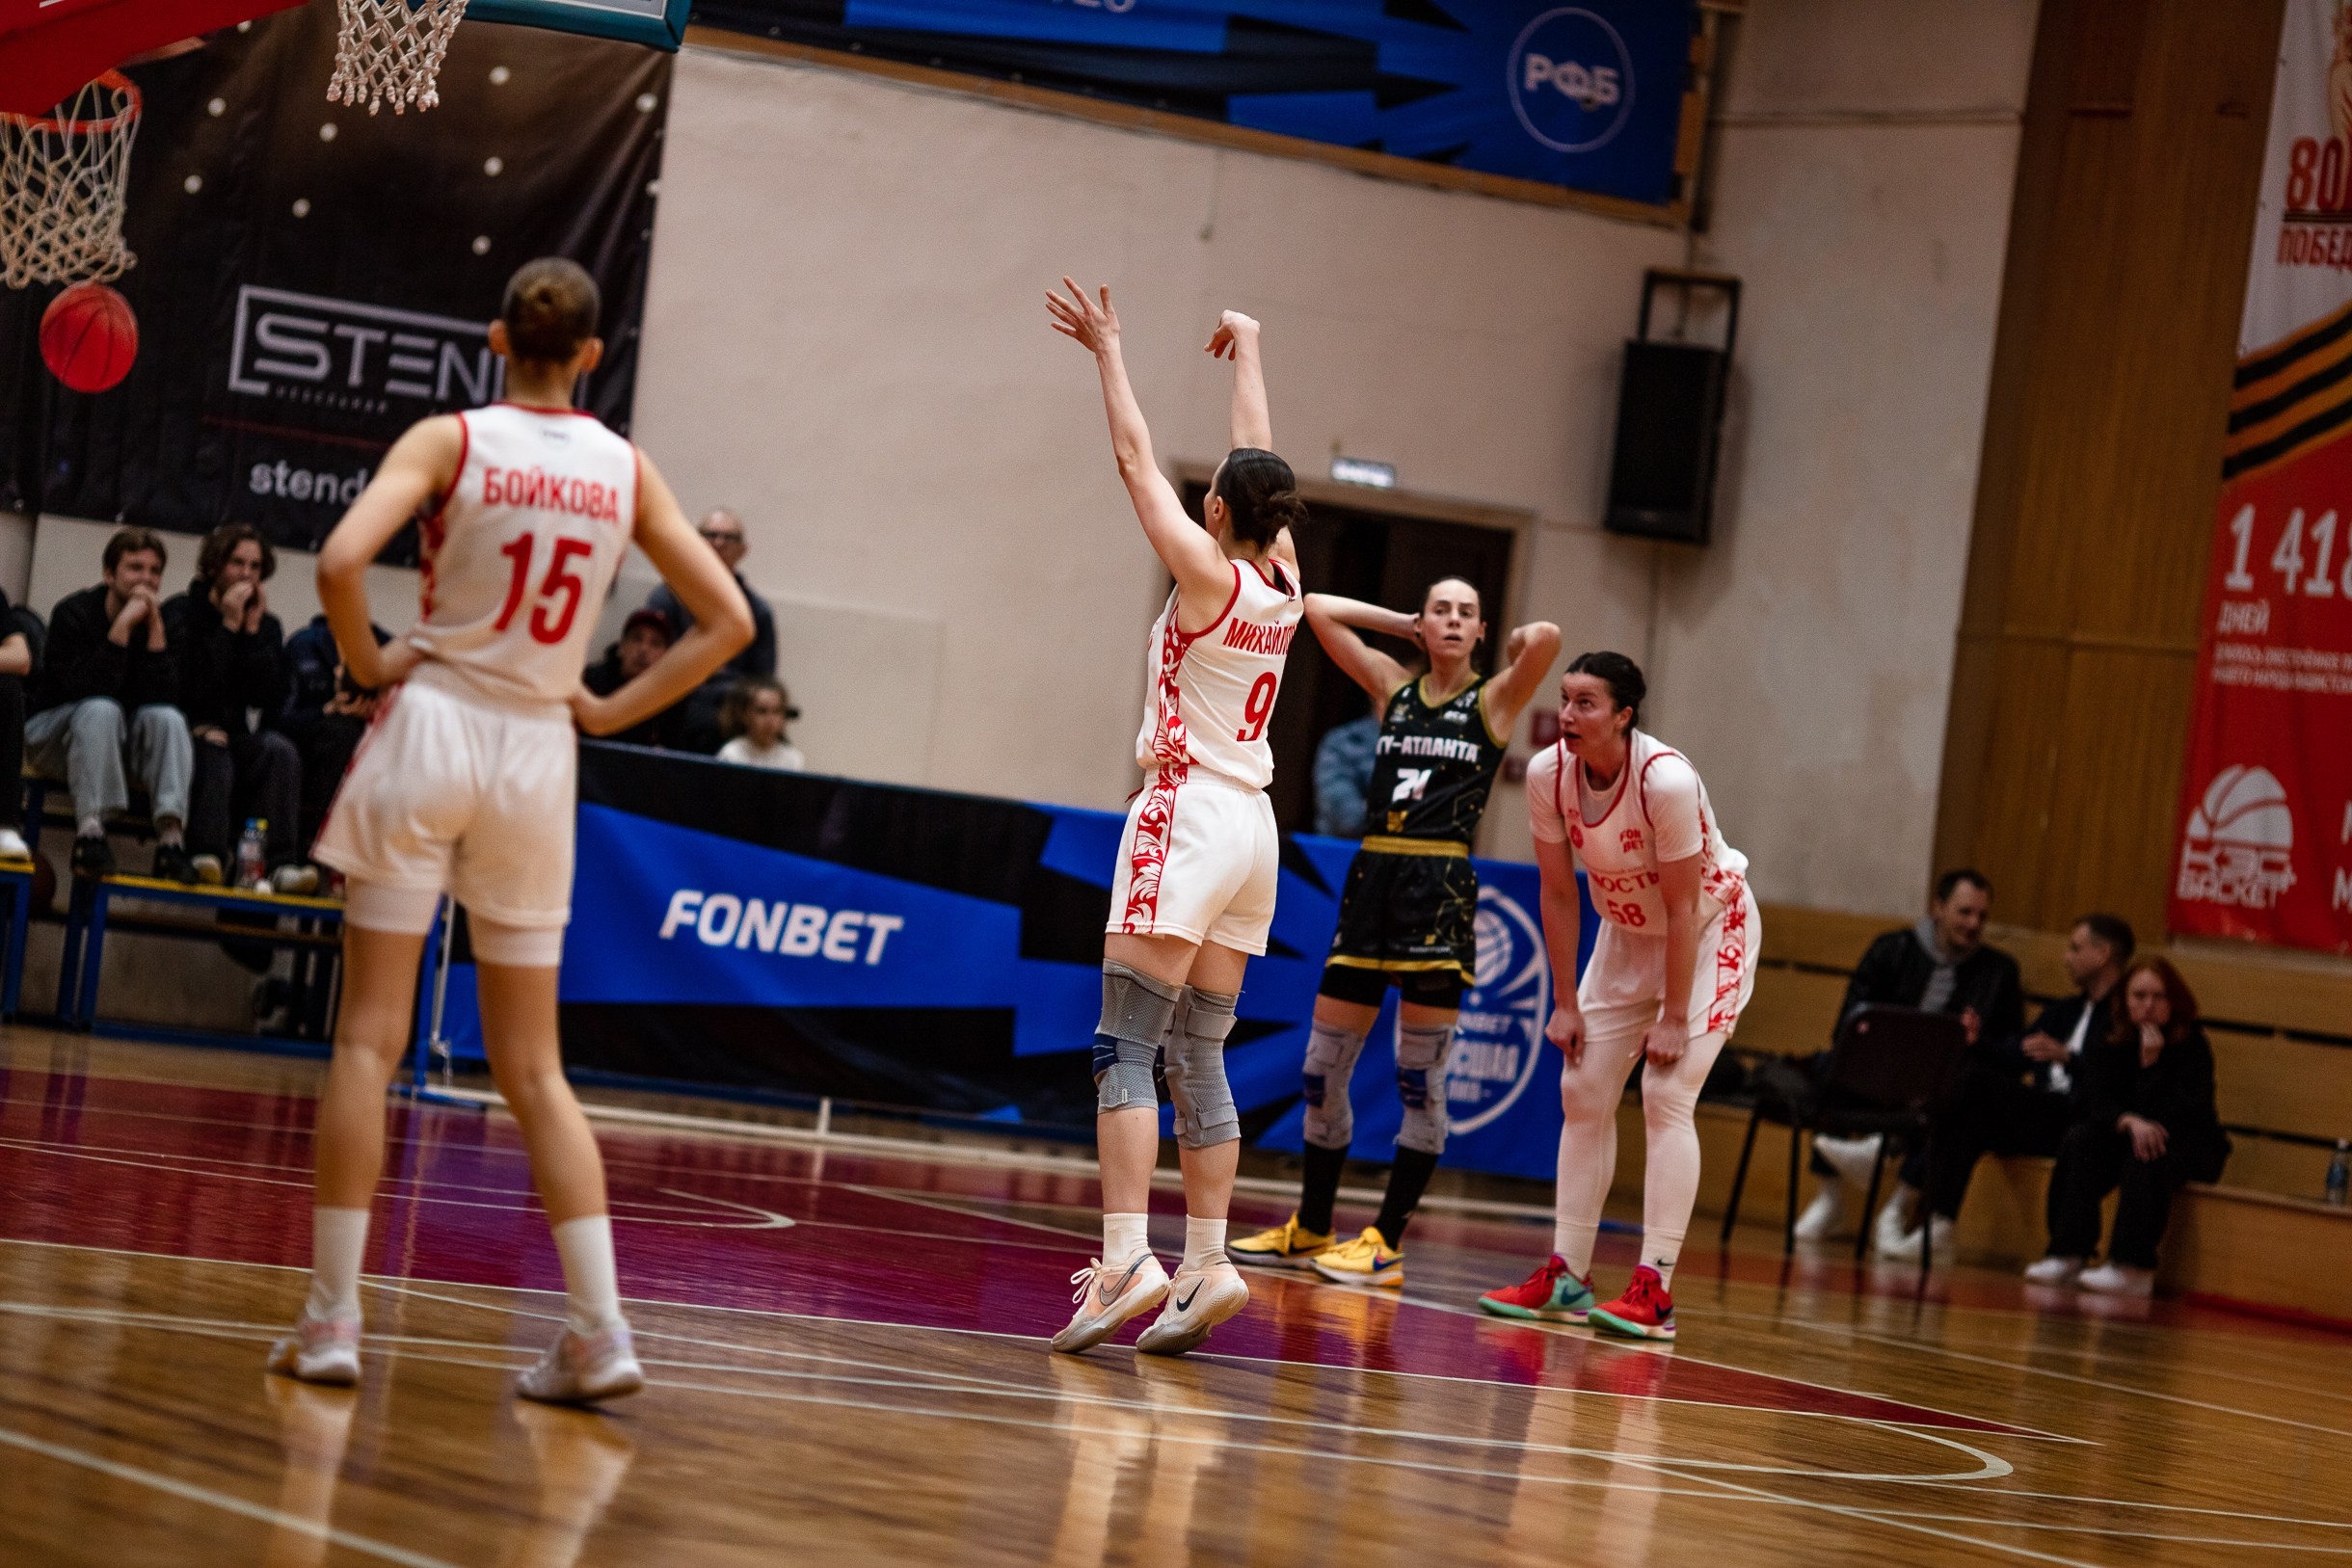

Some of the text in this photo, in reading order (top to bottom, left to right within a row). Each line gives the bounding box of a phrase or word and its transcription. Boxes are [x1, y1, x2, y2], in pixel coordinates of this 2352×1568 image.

[1524, 52, 1621, 106] РФБ
[2287, 137, 2343, 211] 80
[483, 465, 620, 523] БОЙКОВА
[2224, 502, 2256, 592] 1
[494, 530, 594, 646] 15
[1236, 671, 1277, 742] 9
[1619, 829, 1642, 843] FON
[1623, 839, 1644, 854] BET
[659, 889, 904, 966] FONBET
[1607, 899, 1646, 927] 58
